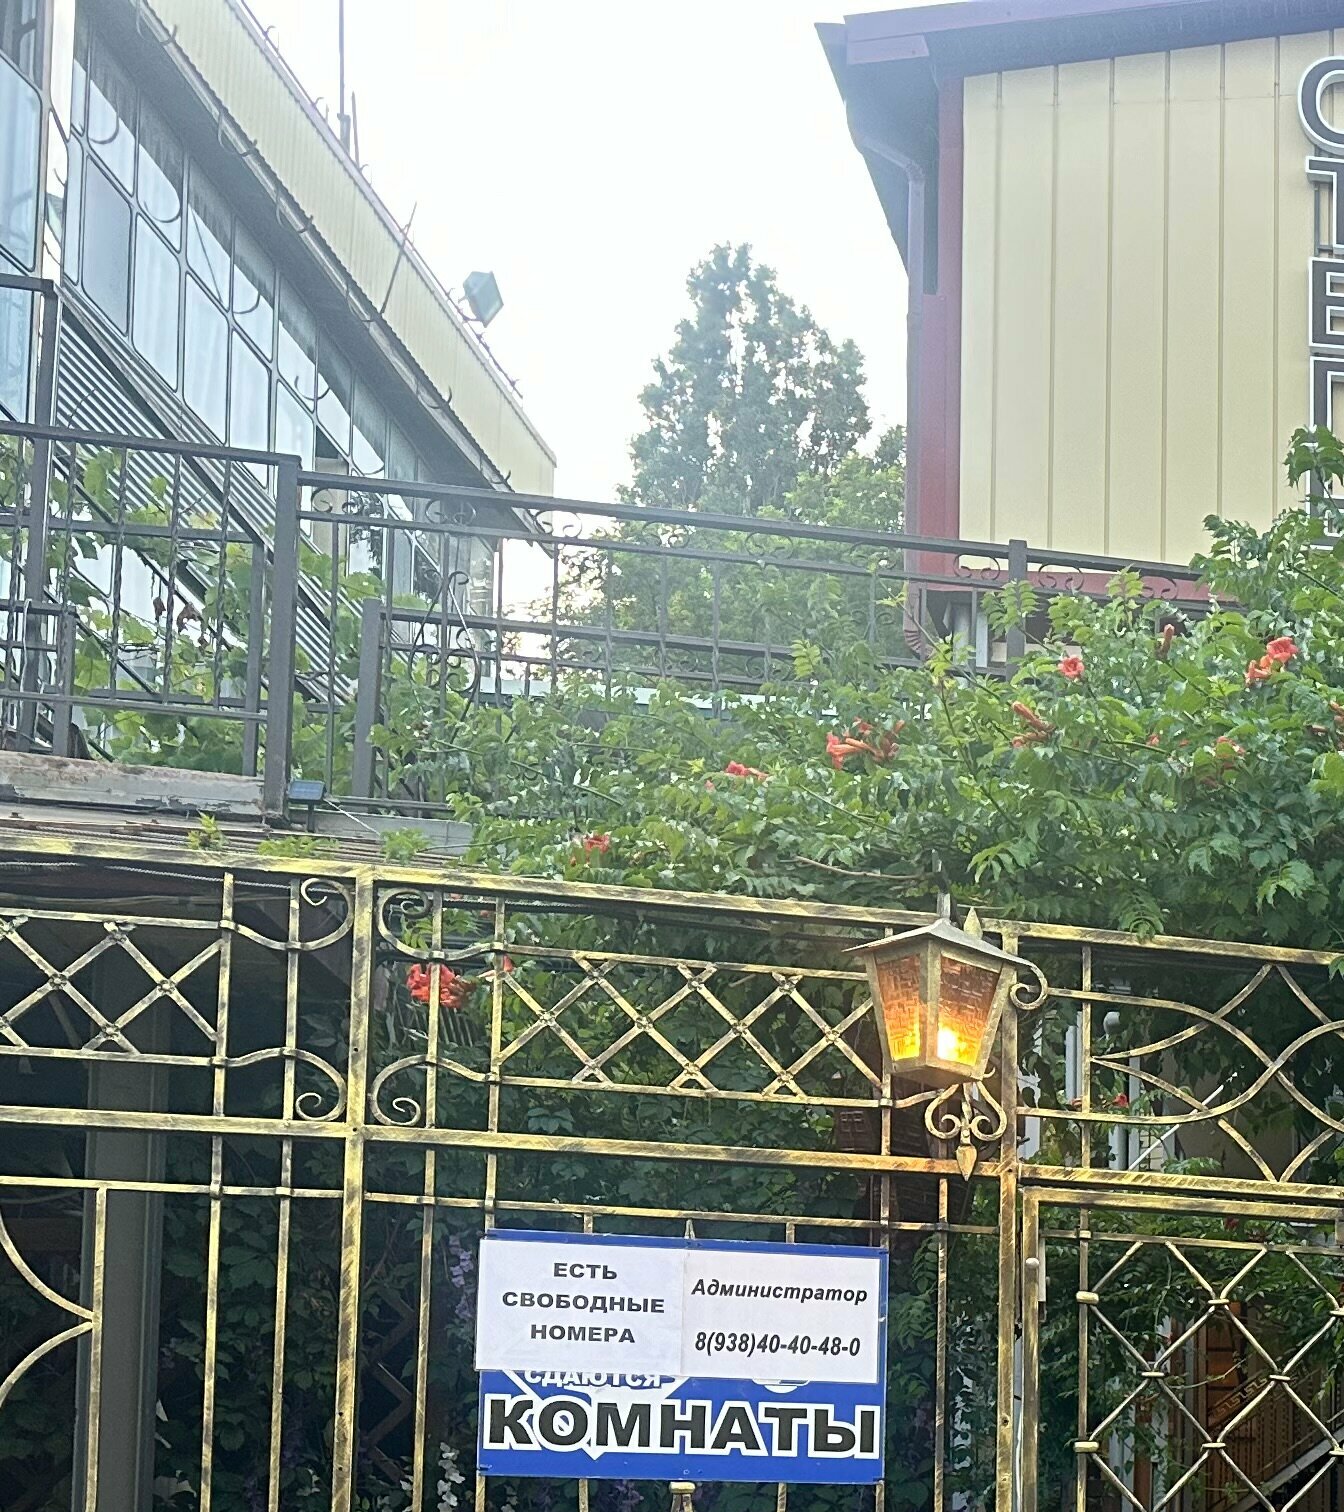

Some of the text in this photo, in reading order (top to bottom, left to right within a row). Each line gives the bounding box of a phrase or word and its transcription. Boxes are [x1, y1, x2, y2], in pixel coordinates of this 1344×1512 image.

[553, 1262, 618, 1281] ЕСТЬ
[502, 1291, 665, 1314] СВОБОДНЫЕ
[691, 1279, 868, 1304] Администратор
[529, 1324, 636, 1344] НОМЕРА
[694, 1331, 862, 1358] 8(938)40-40-48-0
[484, 1394, 881, 1460] КОМНАТЫ
